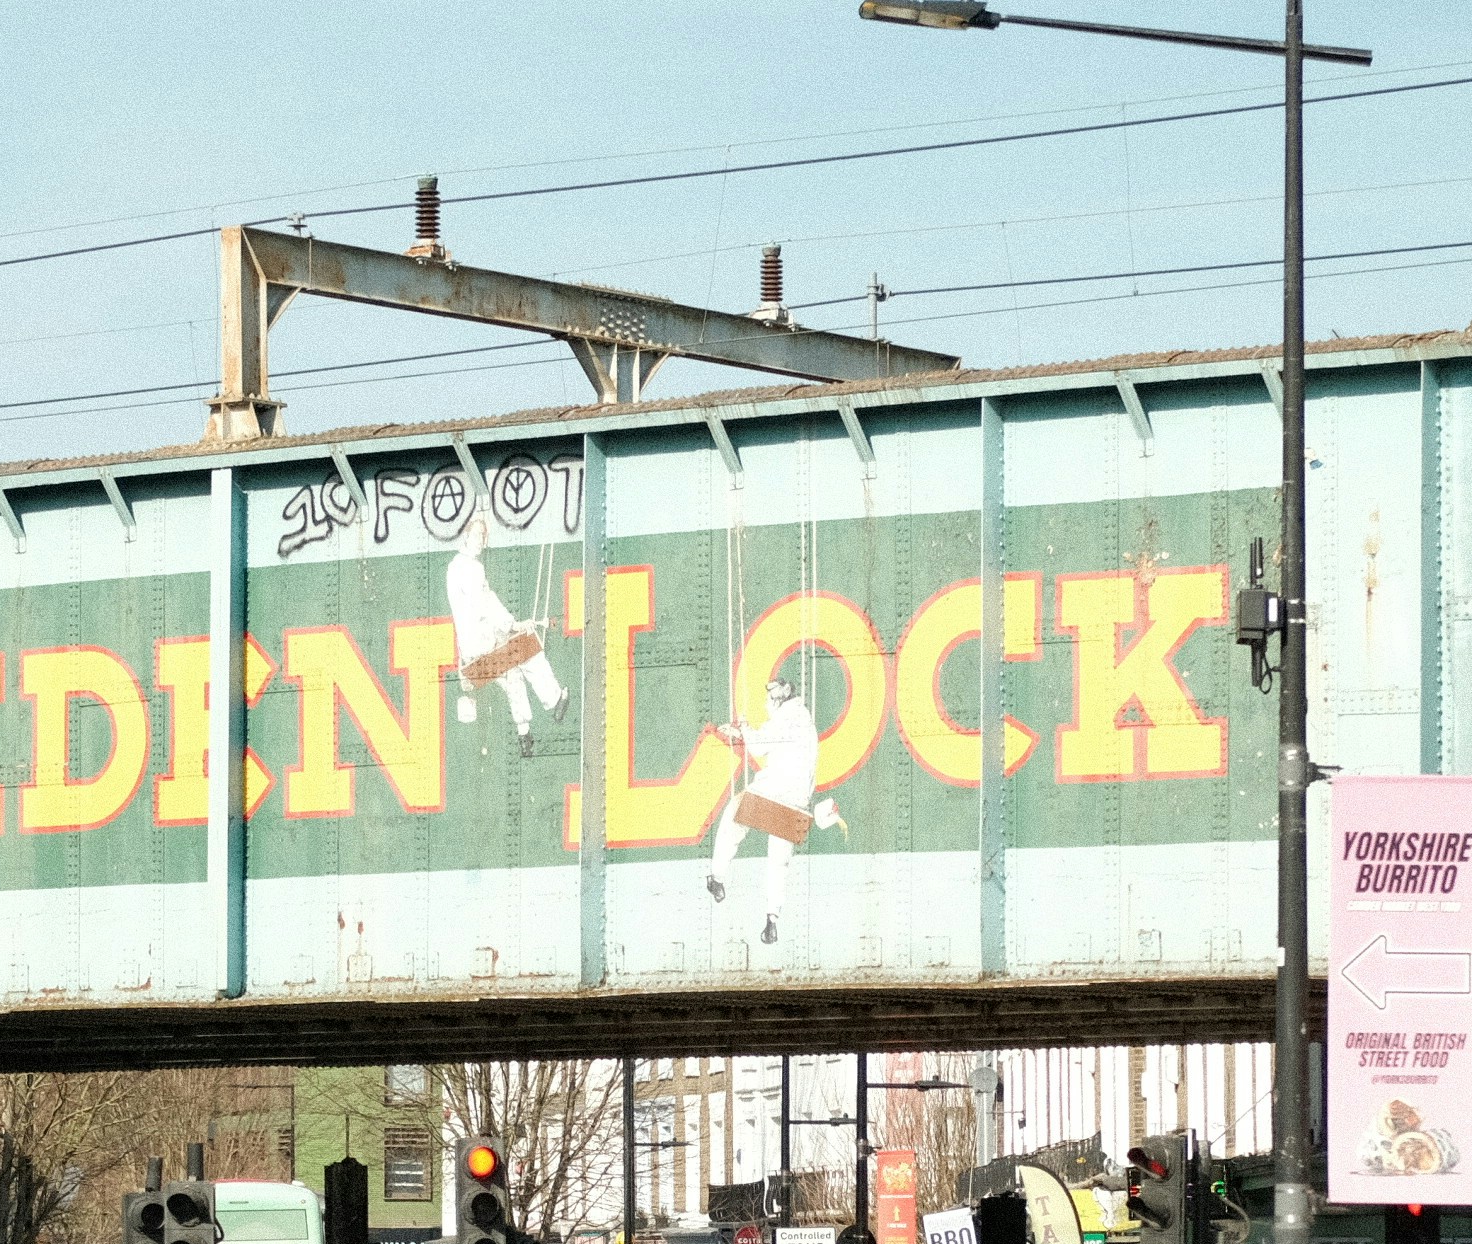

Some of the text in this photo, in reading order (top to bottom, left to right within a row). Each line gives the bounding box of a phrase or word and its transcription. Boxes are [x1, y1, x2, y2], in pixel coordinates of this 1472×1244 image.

[562, 561, 1230, 852] LOCK
[1355, 864, 1458, 894] BURRITO
[1345, 1032, 1467, 1050] ORIGINAL BRITISH
[1358, 1050, 1449, 1068] STREET FOOD
[780, 1231, 831, 1240] Controlled
